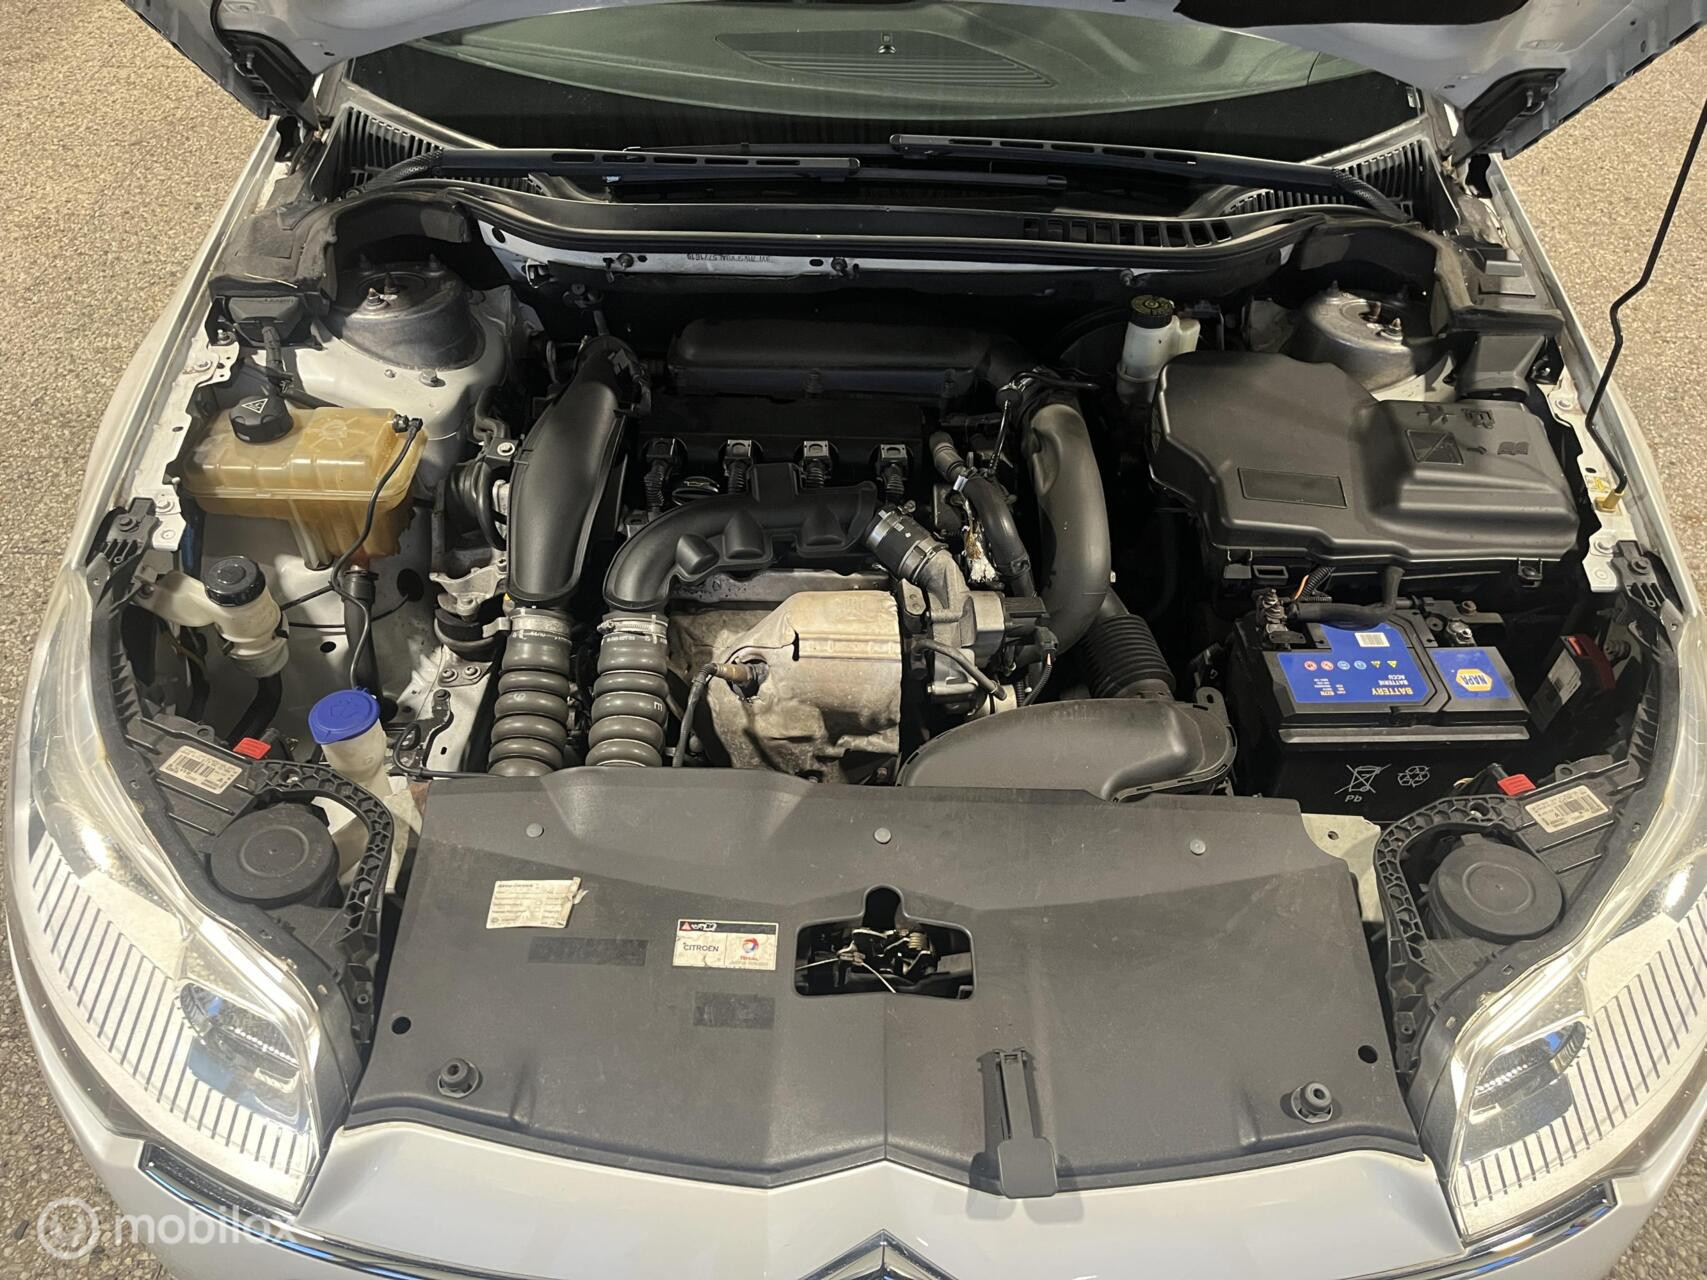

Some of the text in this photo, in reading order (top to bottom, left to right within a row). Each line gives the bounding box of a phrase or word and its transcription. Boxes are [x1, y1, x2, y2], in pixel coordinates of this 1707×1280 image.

[1460, 674, 1488, 686] NAPA
[1371, 687, 1414, 696] BATTERY
[1345, 795, 1363, 803] Pb
